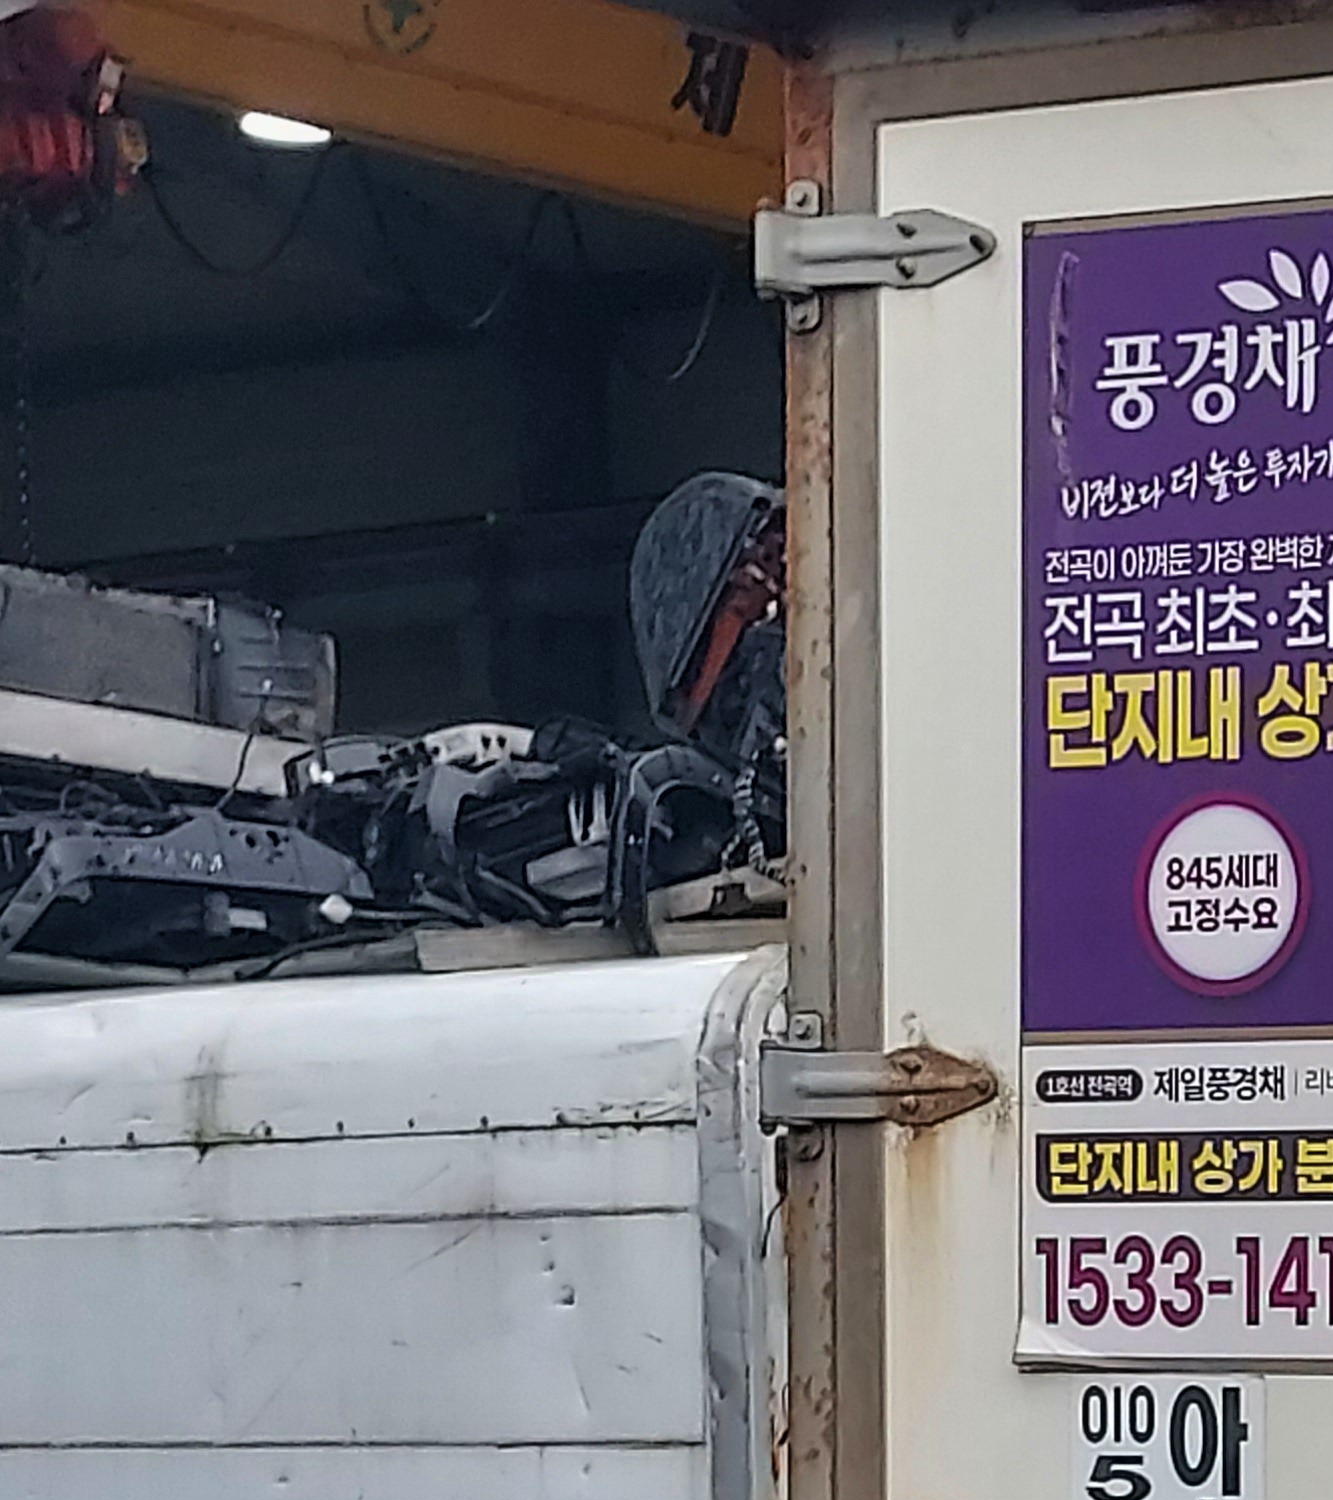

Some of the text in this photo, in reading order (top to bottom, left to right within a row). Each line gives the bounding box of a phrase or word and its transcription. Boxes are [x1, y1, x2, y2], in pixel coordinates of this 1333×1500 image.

[1095, 318, 1321, 431] 풍경채
[1061, 474, 1165, 519] 비전보다
[1170, 461, 1198, 500] 더
[1204, 449, 1258, 502] 높은
[1045, 547, 1115, 583] 전곡이
[1121, 543, 1193, 578] 아껴둔
[1197, 539, 1245, 575] 가장
[1250, 534, 1323, 571] 완벽한
[1044, 591, 1145, 664] 전곡
[1046, 666, 1241, 769] 단지내
[1166, 853, 1279, 891] 845세대
[1166, 897, 1279, 933] 고정수요
[1153, 1065, 1285, 1102] 제일풍경채
[1049, 1139, 1178, 1195] 단지내
[1192, 1138, 1283, 1194] 상가
